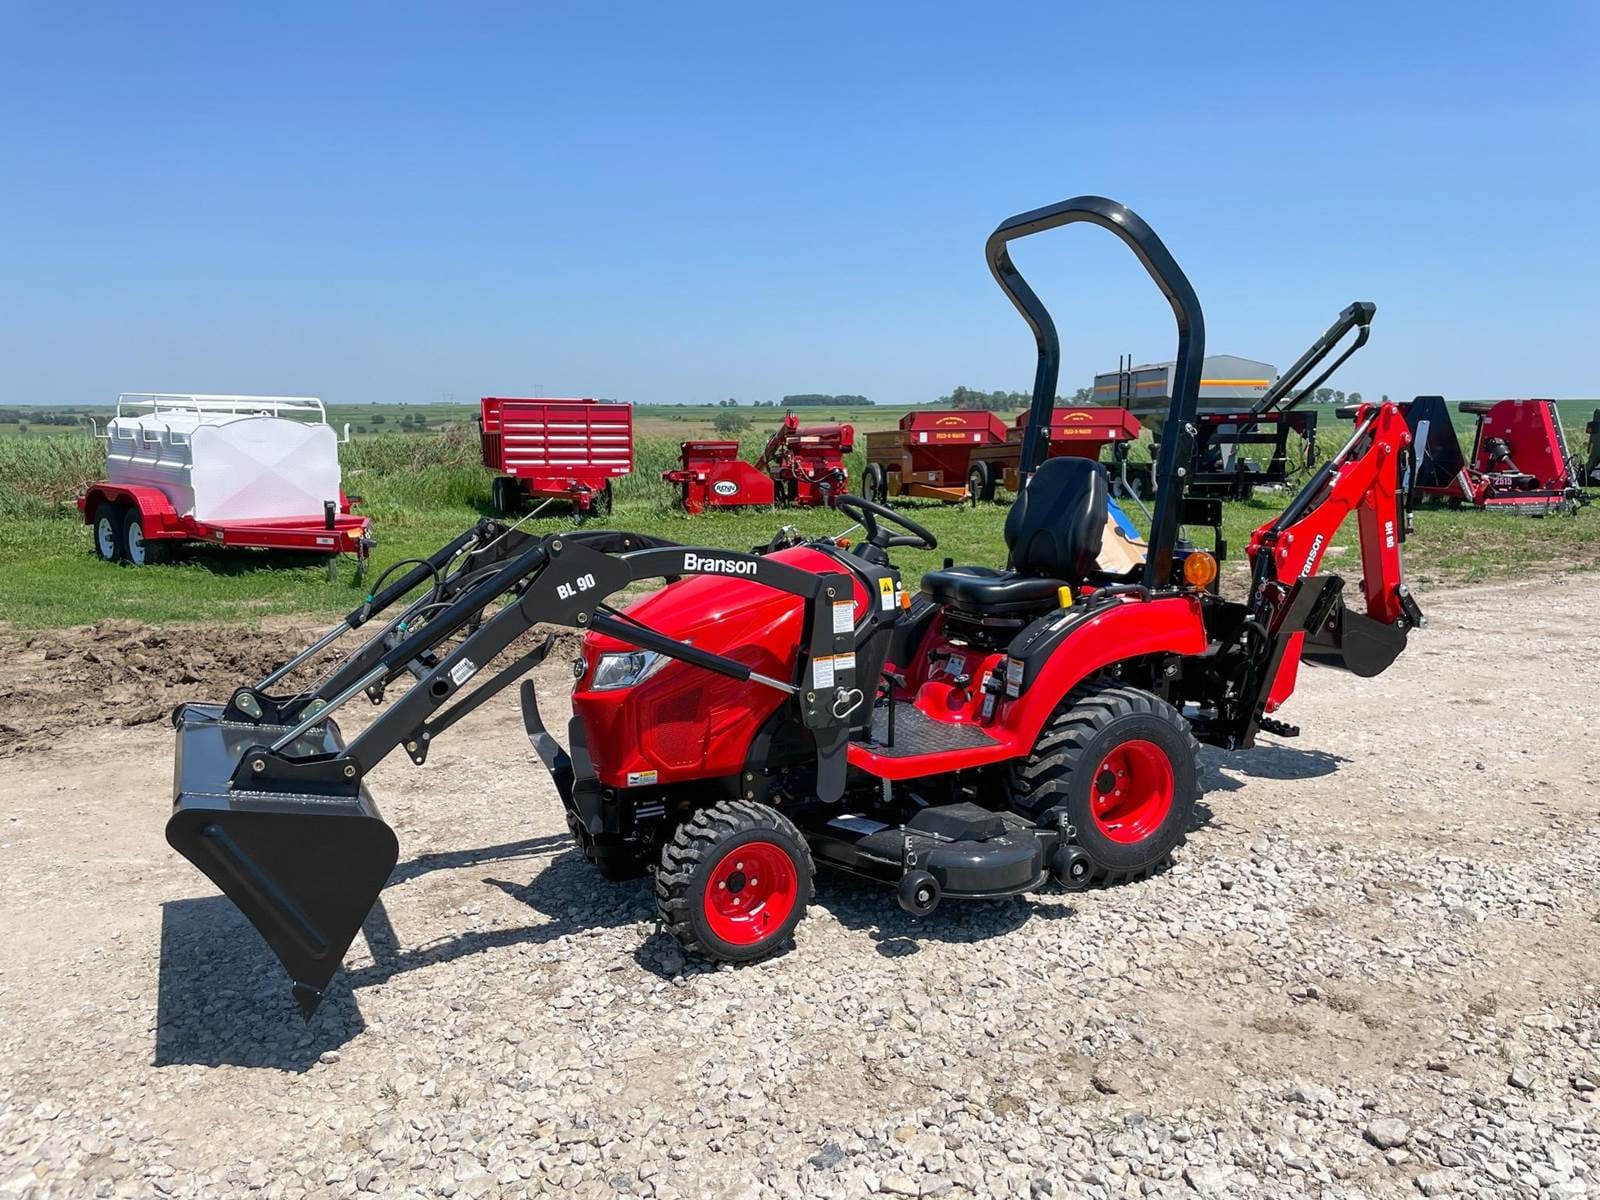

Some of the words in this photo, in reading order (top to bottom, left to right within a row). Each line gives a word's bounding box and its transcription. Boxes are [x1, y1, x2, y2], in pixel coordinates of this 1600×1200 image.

[1494, 477, 1512, 486] 2515
[1385, 521, 1394, 535] BH
[684, 553, 758, 574] Branson
[1300, 534, 1324, 577] ranson
[557, 584, 577, 600] BL
[577, 573, 596, 591] 90
